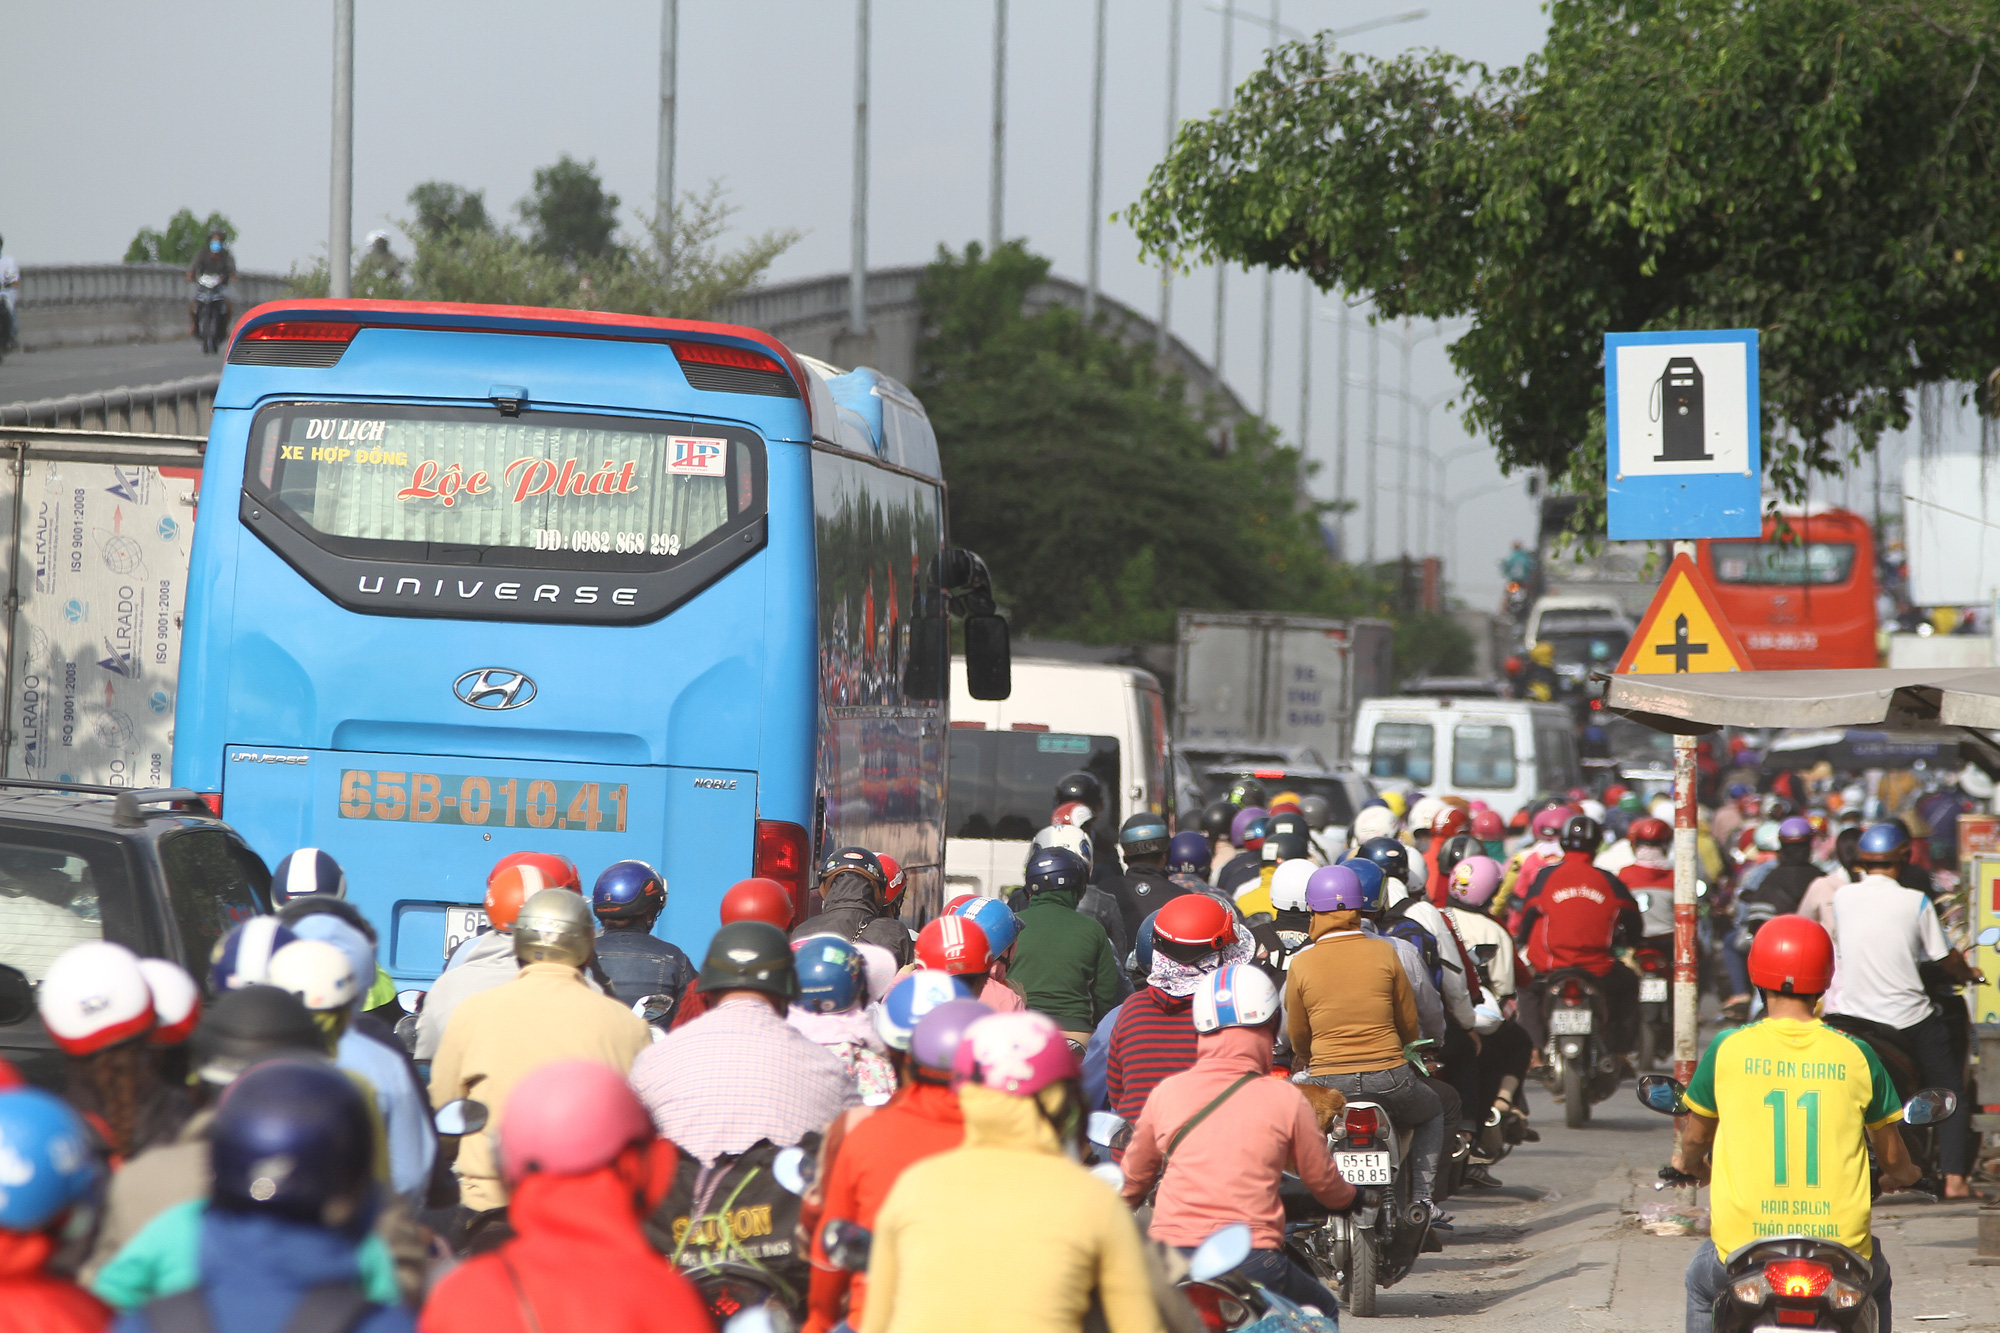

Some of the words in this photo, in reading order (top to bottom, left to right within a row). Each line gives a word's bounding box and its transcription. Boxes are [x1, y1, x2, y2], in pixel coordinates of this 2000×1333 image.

[305, 418, 337, 440] DU
[338, 420, 386, 447] LỊCH
[280, 445, 305, 460] XE
[311, 446, 351, 464] HỢP
[355, 445, 408, 467] ĐỒNG
[397, 459, 492, 507] Lộc
[503, 457, 639, 503] Phát
[72, 488, 86, 549] 9001:2008
[571, 530, 611, 553] 0982
[615, 531, 645, 555] 868
[650, 533, 681, 556] 292
[71, 551, 82, 573] ISO
[358, 575, 639, 607] UNIVERSE
[157, 580, 171, 640] 9001:2008
[96, 586, 134, 679] ALRADO
[156, 643, 168, 664] ISO
[64, 662, 77, 722] 9001:2008
[63, 725, 74, 747] ISO
[693, 778, 738, 790] NOBLE
[340, 770, 628, 832] 65B-010.41
[1744, 1057, 1772, 1076] AFC
[1777, 1060, 1797, 1078] AN
[1801, 1062, 1847, 1081] GIANG
[1764, 1088, 1821, 1188] 11
[1761, 1200, 1790, 1215] HAIR
[1792, 1200, 1831, 1216] SALON
[1787, 1223, 1841, 1238] ARSENAL
